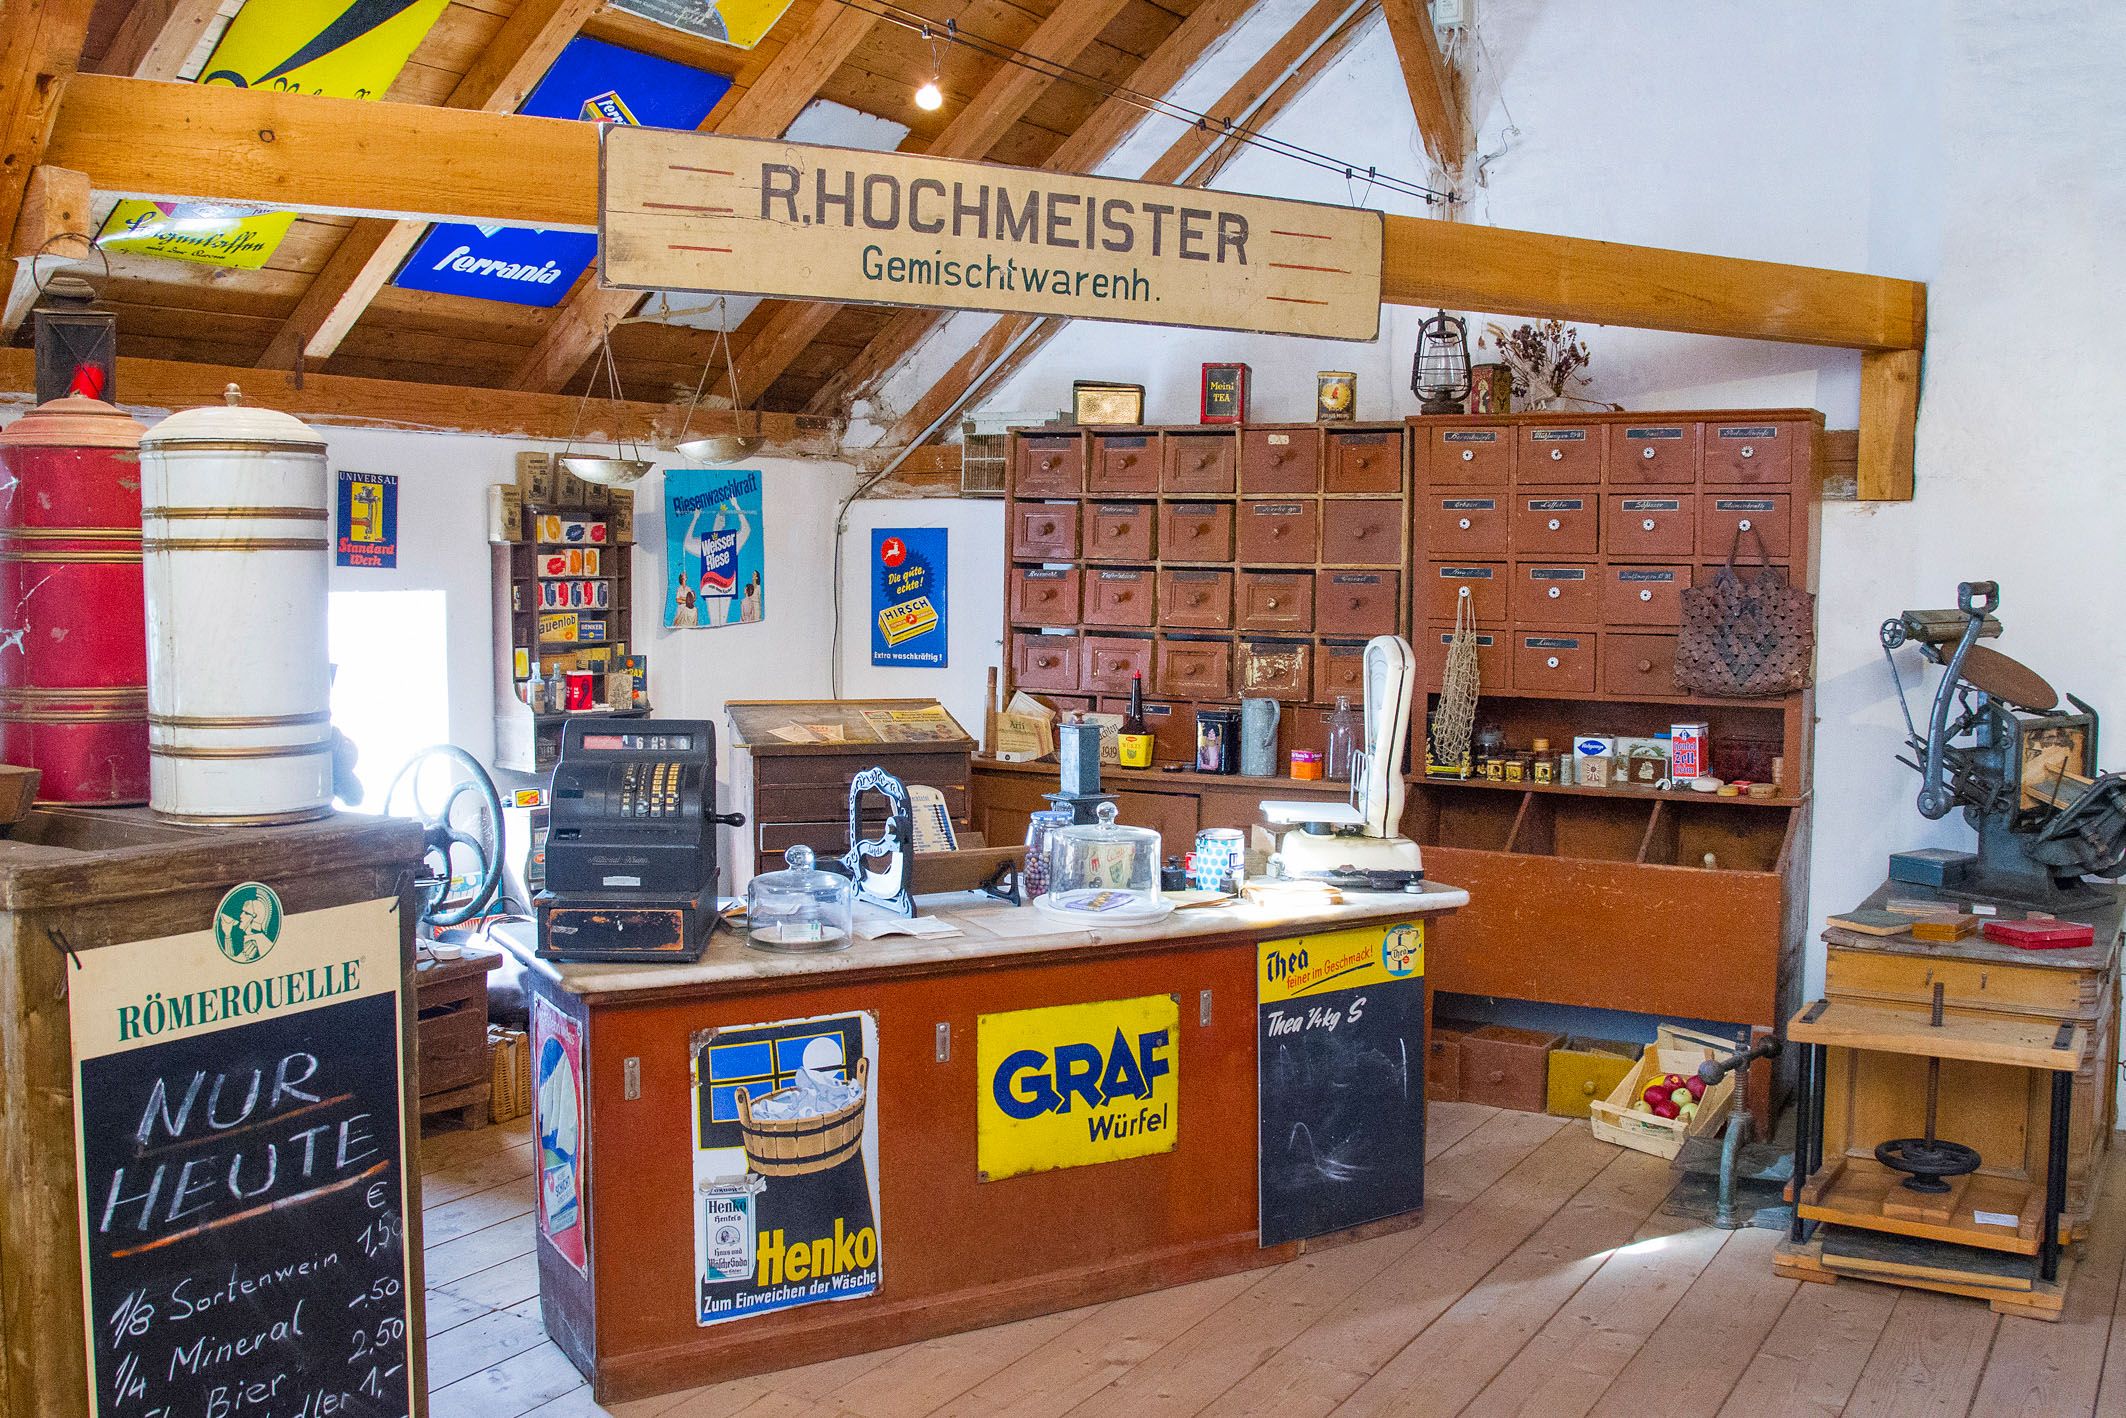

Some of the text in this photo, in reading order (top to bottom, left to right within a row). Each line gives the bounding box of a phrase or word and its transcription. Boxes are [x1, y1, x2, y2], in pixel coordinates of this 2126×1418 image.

[760, 162, 1250, 265] R.HOCHMEISTER
[432, 245, 562, 285] ferrania
[862, 244, 1162, 303] Gemischtwarenh.
[1213, 393, 1230, 402] TEA
[339, 471, 398, 485] UNIVERSAL
[673, 473, 758, 518] Riesenwaschkraft
[338, 537, 395, 555] Standard
[350, 554, 382, 566] Werk
[701, 532, 735, 557] Weisser
[705, 551, 730, 572] Riese
[888, 573, 901, 585] Die
[896, 576, 924, 595] echte!
[884, 599, 929, 621] HIRSCH
[874, 651, 891, 660] Extra
[1266, 949, 1309, 983] Thea
[1287, 945, 1374, 990] feiner im Geschmack!
[117, 958, 361, 1042] RÖMERQUELLE
[1268, 1010, 1304, 1037] Thea
[1347, 997, 1367, 1024] S
[993, 1026, 1170, 1120] GRAF
[137, 1051, 321, 1146] NUR
[1088, 1103, 1168, 1143] Würfel
[100, 1113, 379, 1232] HEUTE
[367, 1181, 387, 1208] €
[708, 1199, 747, 1214] Henko
[757, 1218, 877, 1287] Henko
[169, 1252, 338, 1321] Sortenwein
[704, 1269, 877, 1313] Zum Einweichen der Wäsche
[115, 1351, 148, 1407] 1/4
[168, 1299, 304, 1382] Mineral
[206, 1372, 287, 1418] Bier
